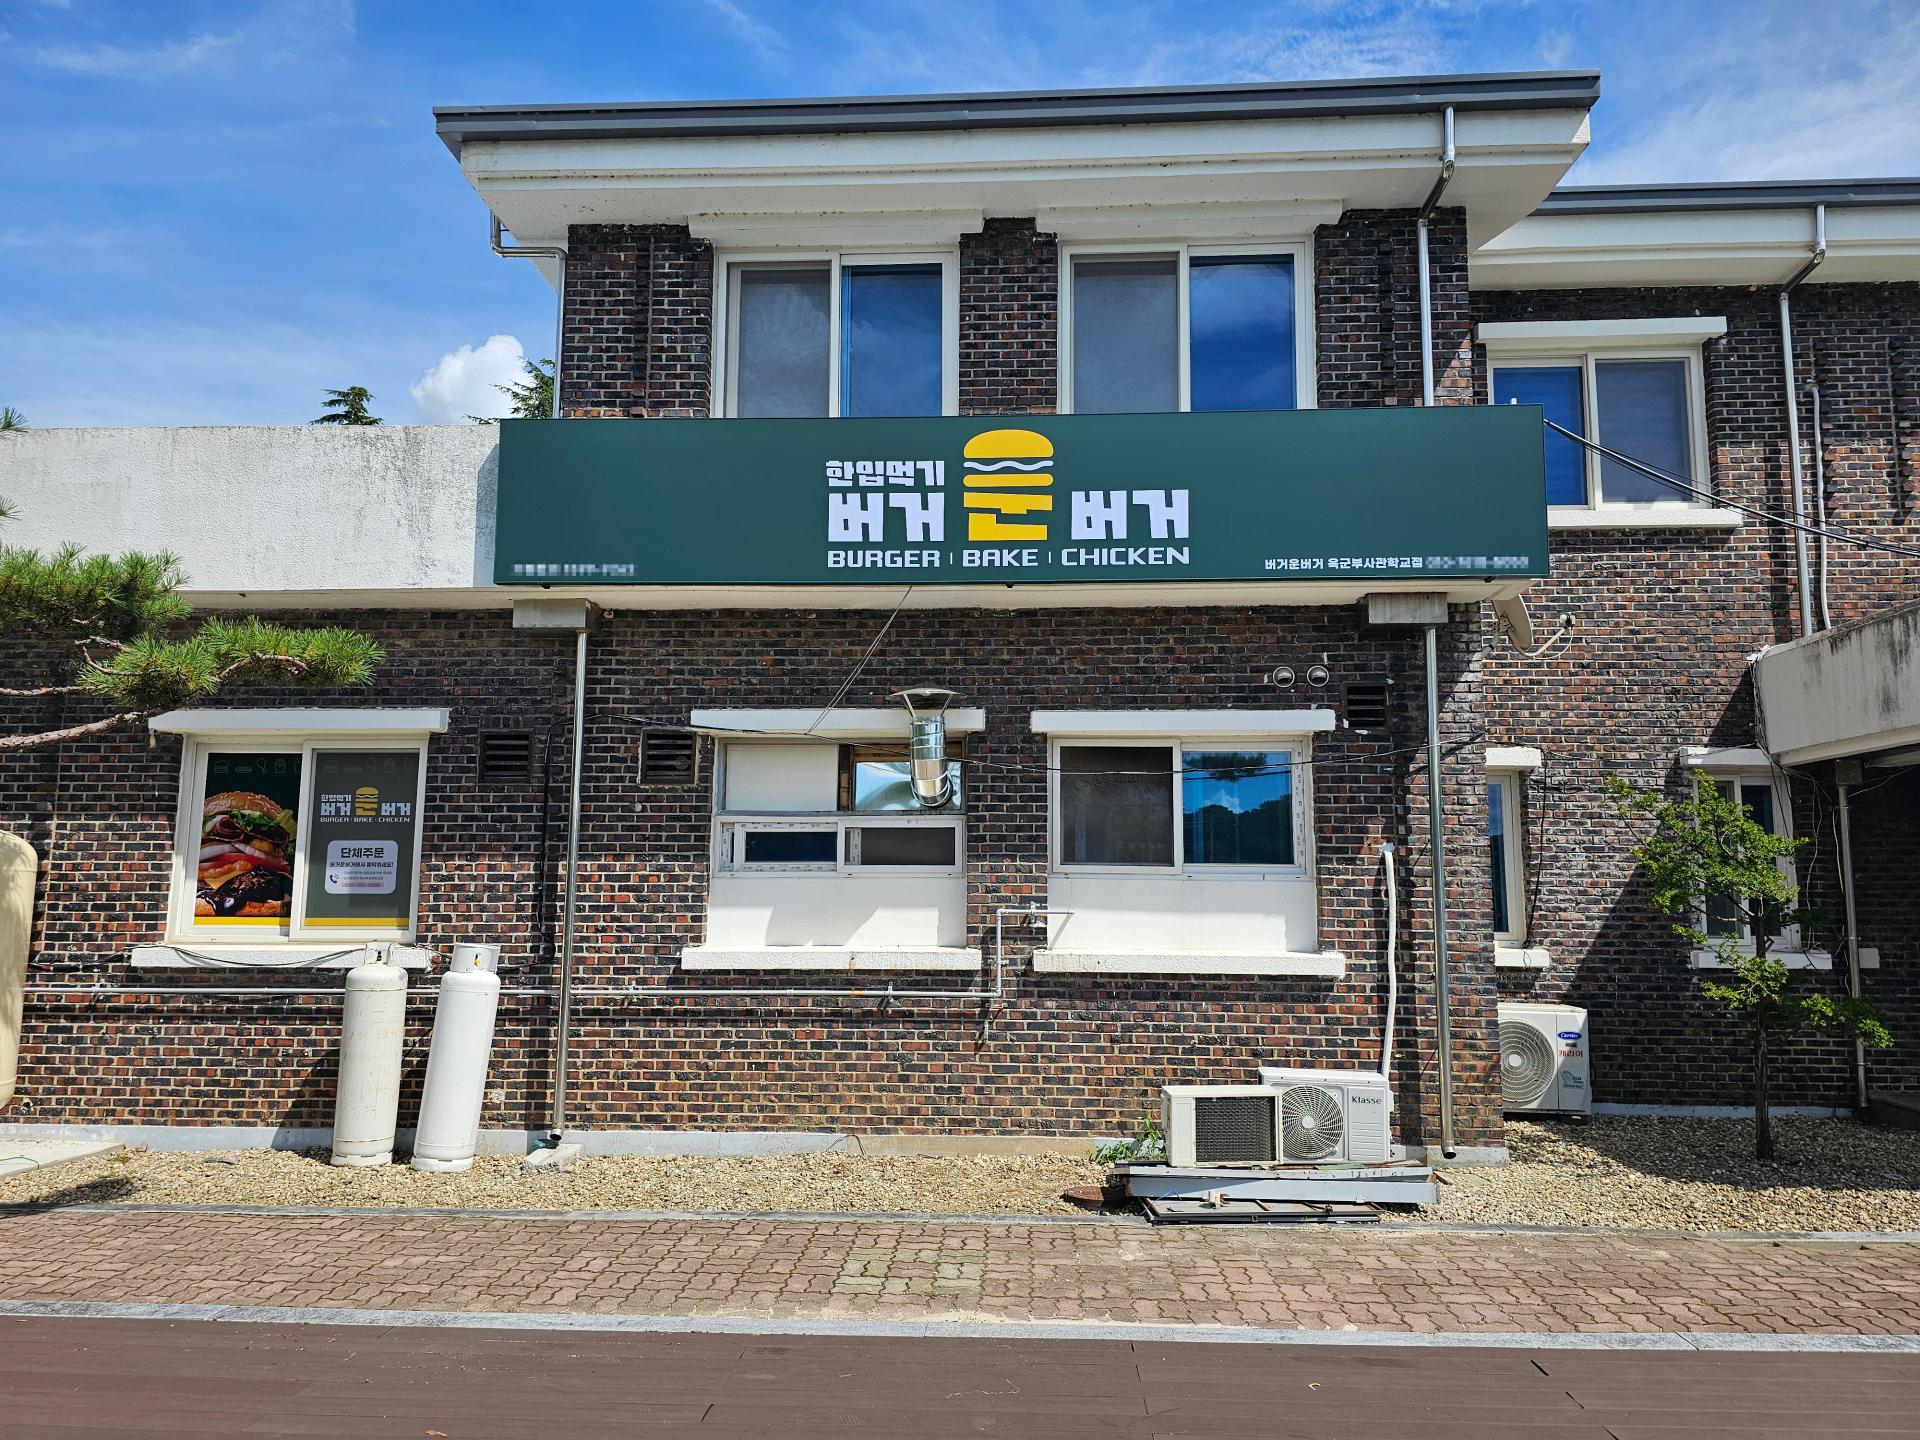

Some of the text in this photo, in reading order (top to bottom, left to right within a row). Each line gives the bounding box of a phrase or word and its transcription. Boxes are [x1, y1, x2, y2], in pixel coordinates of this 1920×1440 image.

[826, 461, 945, 487] 한입먹기
[828, 492, 945, 542] 버거
[1071, 489, 1190, 540] 버거
[827, 547, 1190, 568] BURGER BAKE CHICKEN
[1264, 558, 1324, 570] 버거운버거
[1327, 556, 1423, 569] 육군부사관학교점
[340, 847, 385, 859] 단체주문
[1351, 1095, 1382, 1105] Klasse
